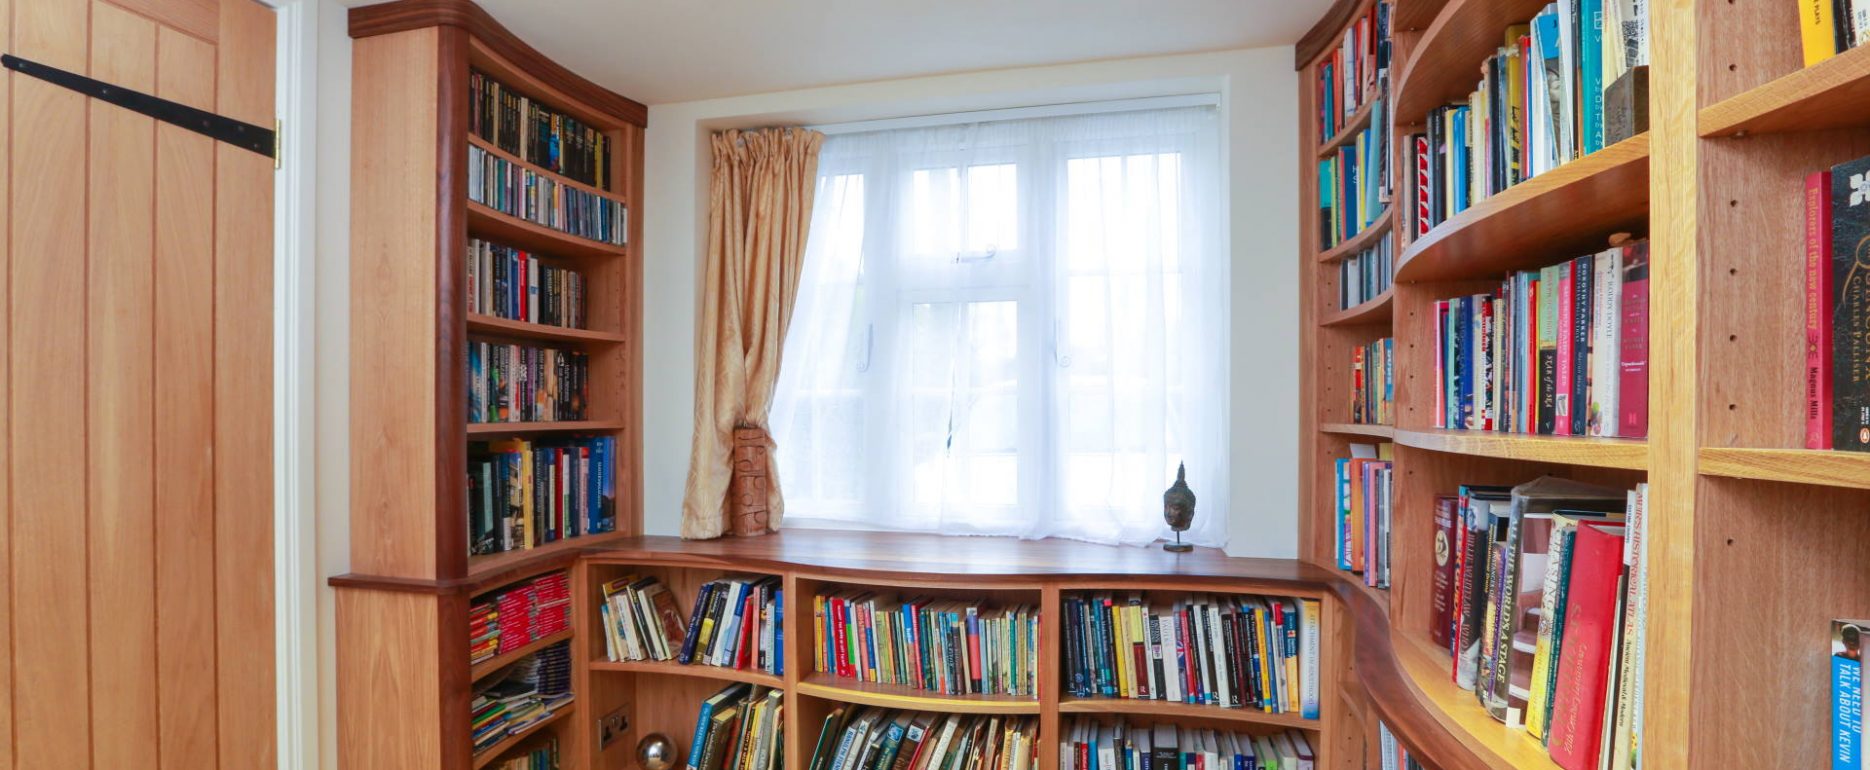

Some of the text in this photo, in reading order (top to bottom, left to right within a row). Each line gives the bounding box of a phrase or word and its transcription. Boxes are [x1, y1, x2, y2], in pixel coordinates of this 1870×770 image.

[1807, 187, 1818, 330] Explorers of the new century
[1853, 276, 1862, 382] CHARLES PALLISER
[1544, 354, 1553, 408] STAR of the SEA
[1809, 367, 1819, 420] Magnus Mills
[1630, 530, 1642, 598] HISTORICAL
[1497, 518, 1519, 684] ALL THE WORLD'S A STAGE
[1626, 599, 1637, 636] ATLAS
[1624, 638, 1632, 664] Ancient
[1618, 702, 1627, 728] Modern
[1839, 664, 1851, 764] TALK ABOUT KEVIN
[1852, 666, 1862, 734] WE NEED TO
